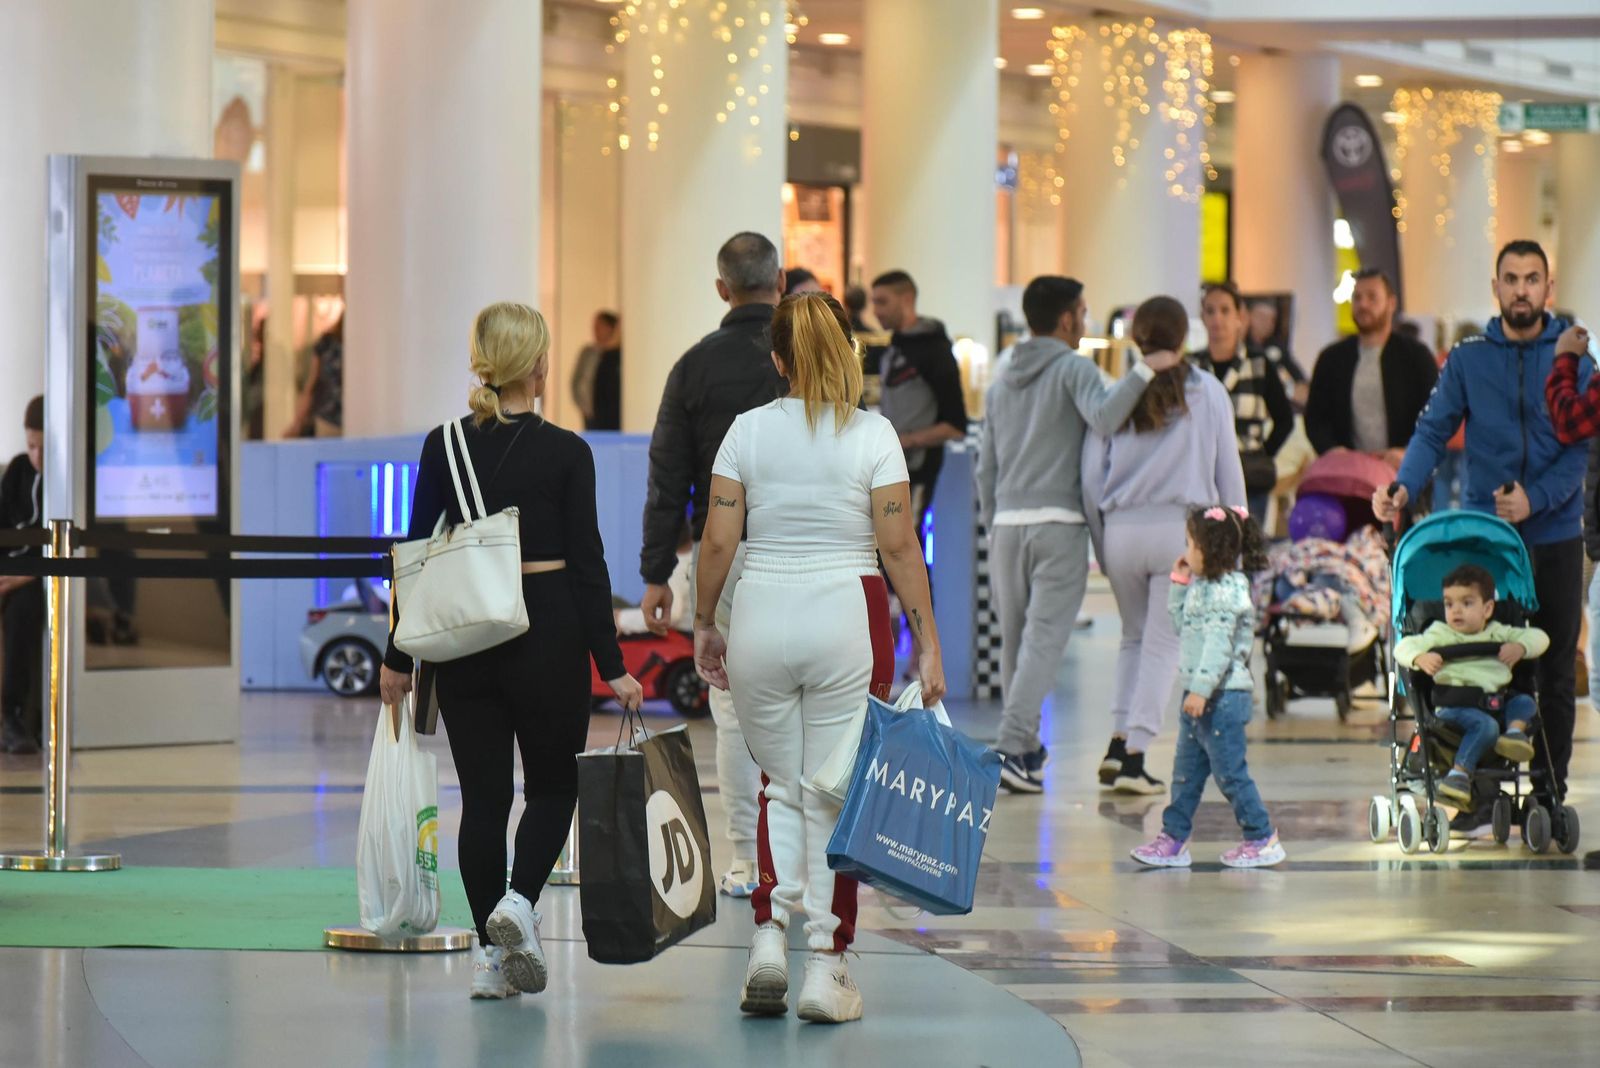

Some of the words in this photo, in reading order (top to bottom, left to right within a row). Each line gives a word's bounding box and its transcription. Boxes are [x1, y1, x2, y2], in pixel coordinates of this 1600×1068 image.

[864, 757, 993, 834] MARYPAZ
[660, 817, 695, 895] JD
[875, 832, 959, 876] www.marypaz.com
[887, 848, 943, 879] #MARYPAZLOVERS
